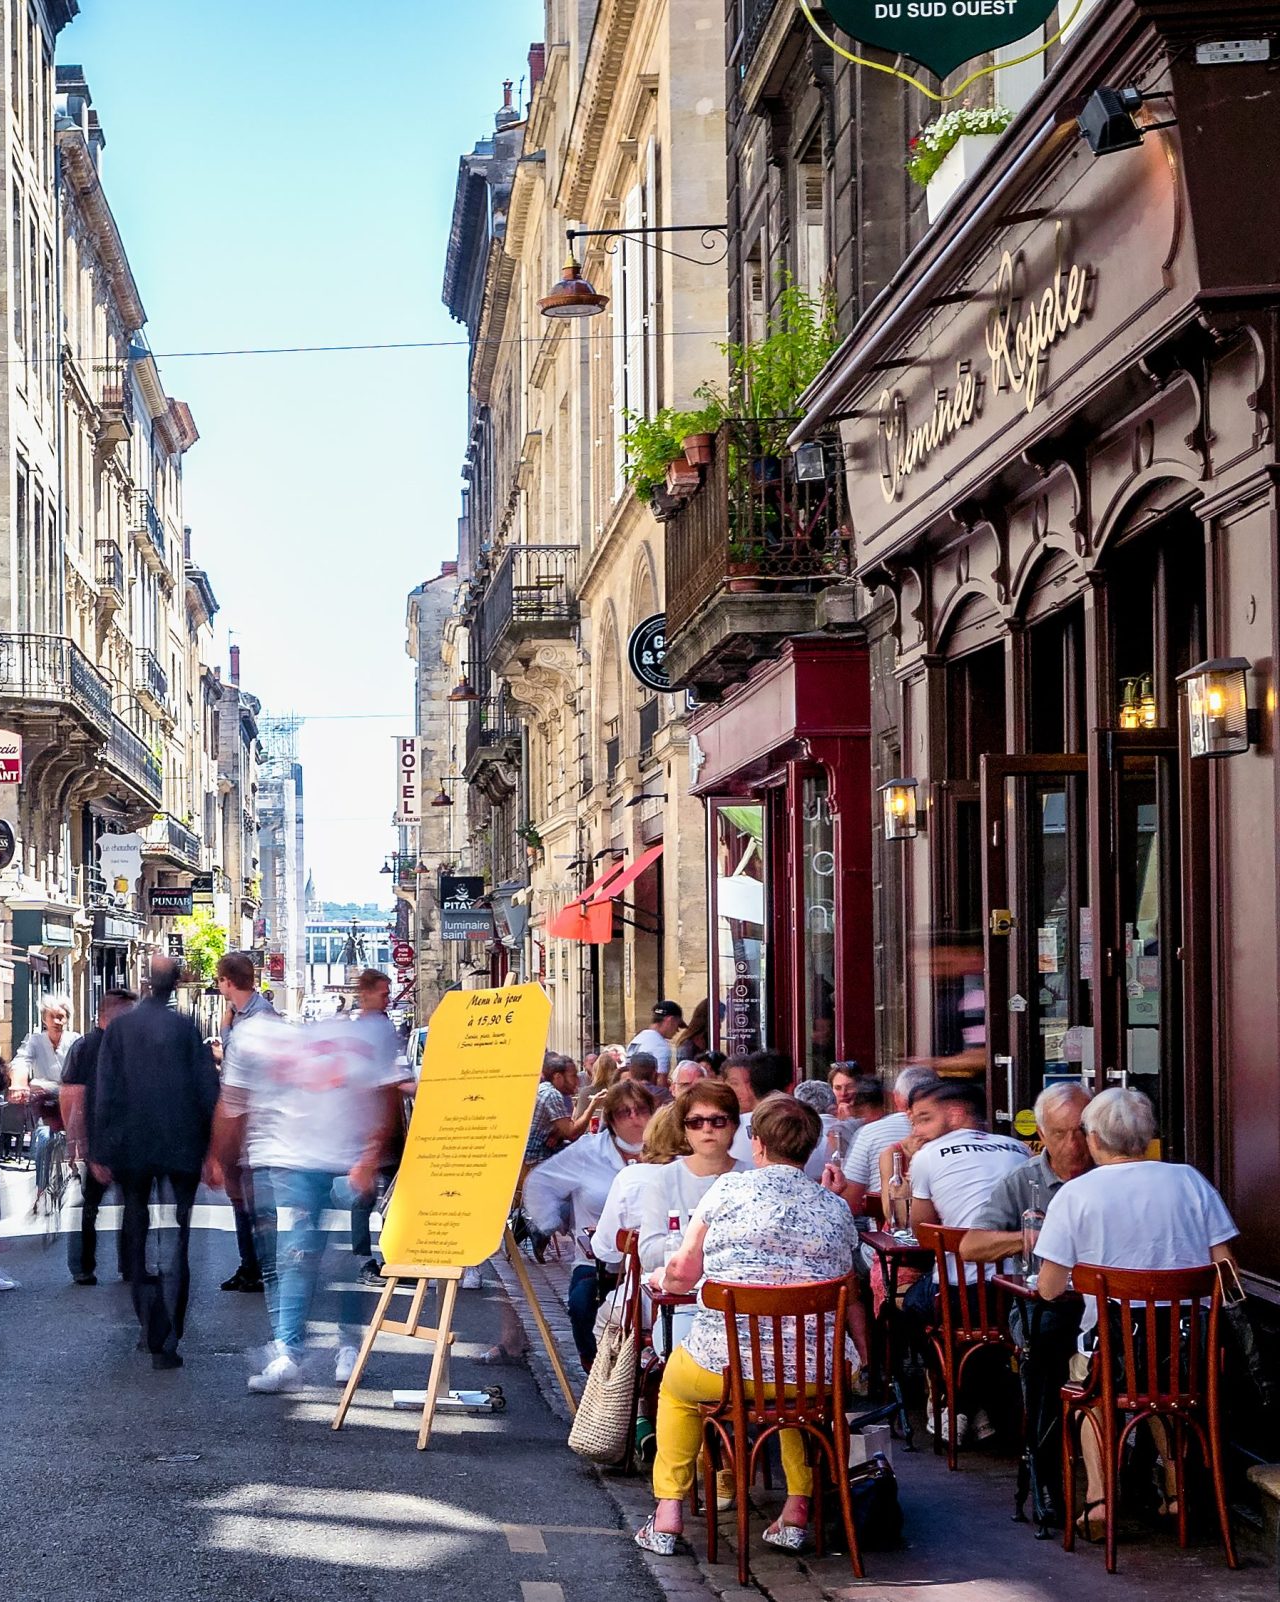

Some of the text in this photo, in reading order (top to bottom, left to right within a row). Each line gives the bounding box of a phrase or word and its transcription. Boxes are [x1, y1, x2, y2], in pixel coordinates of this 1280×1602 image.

[875, 0, 1017, 18] DU SUD OUEST
[986, 221, 1086, 413] Royale
[641, 651, 655, 665] &
[402, 738, 416, 815] HOTEL
[151, 897, 191, 906] PUNJAB
[444, 902, 474, 910] PITAY
[444, 920, 490, 930] luminaire
[466, 993, 523, 1009] Menu du jour
[467, 1015, 474, 1027] à
[505, 1011, 515, 1024] €
